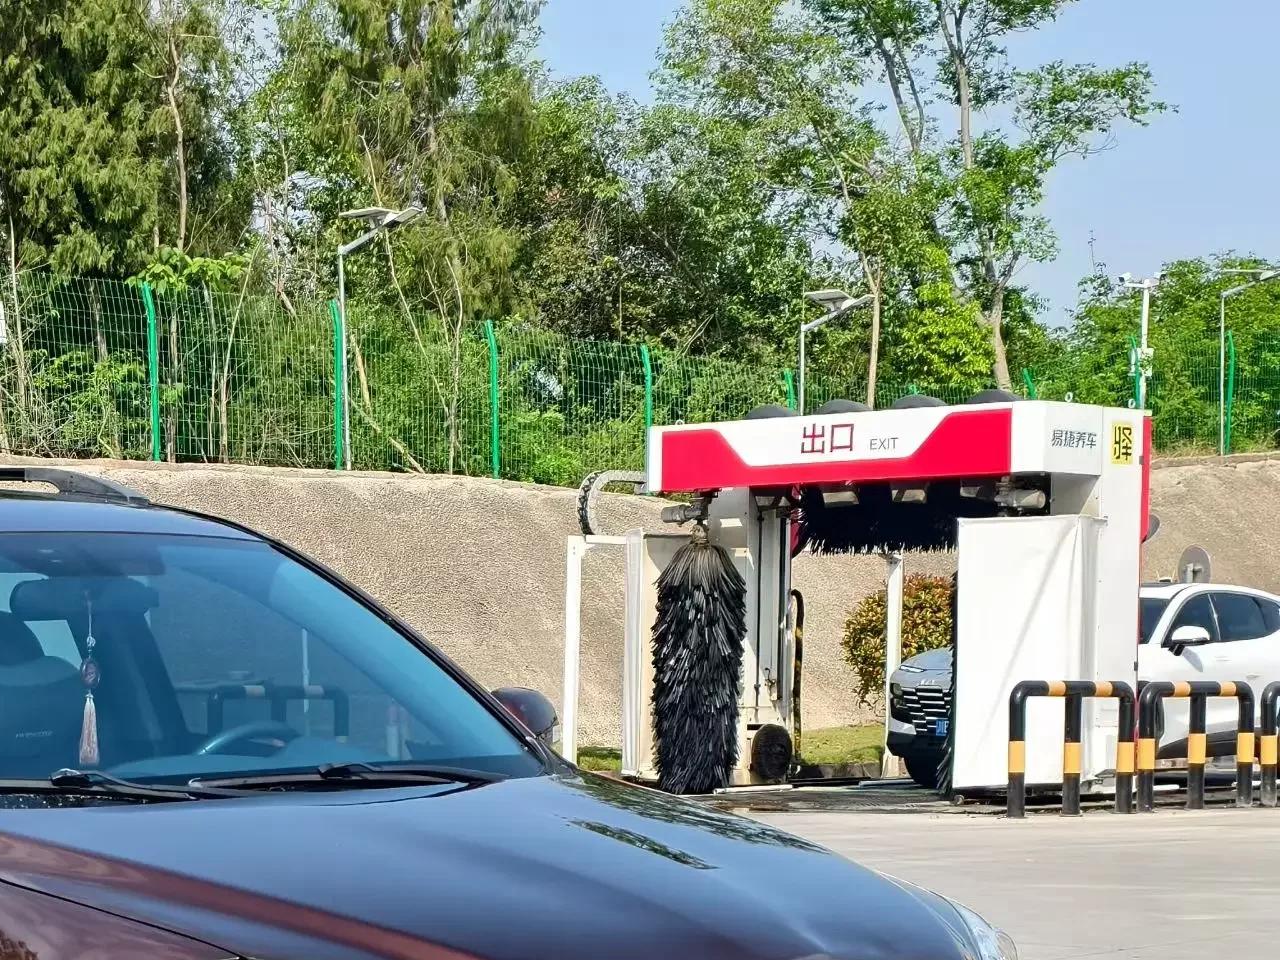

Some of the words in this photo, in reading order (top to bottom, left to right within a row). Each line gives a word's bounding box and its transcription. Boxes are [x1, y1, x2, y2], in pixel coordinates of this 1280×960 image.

[801, 423, 855, 454] 出口
[869, 437, 899, 450] EXIT
[1051, 429, 1098, 449] 易捷养车
